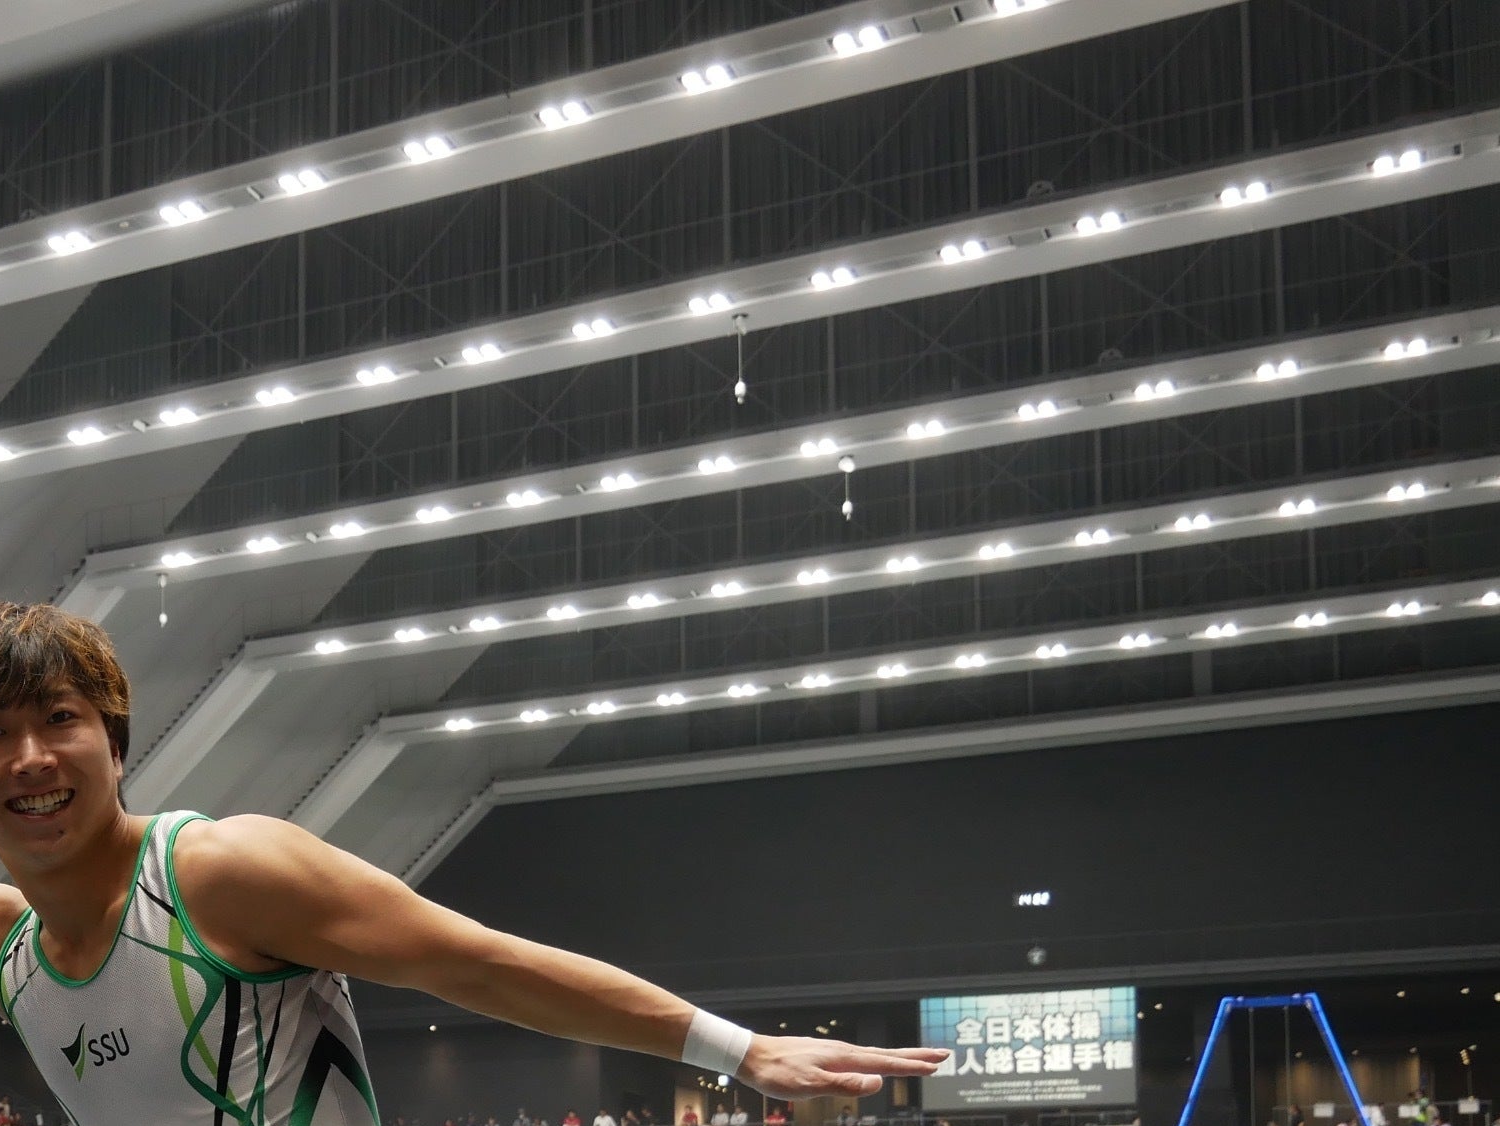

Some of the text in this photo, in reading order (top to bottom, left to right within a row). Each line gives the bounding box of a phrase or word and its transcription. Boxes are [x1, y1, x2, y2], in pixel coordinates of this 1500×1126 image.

[956, 1011, 1101, 1045] 全日本体操
[88, 1028, 129, 1067] SSU
